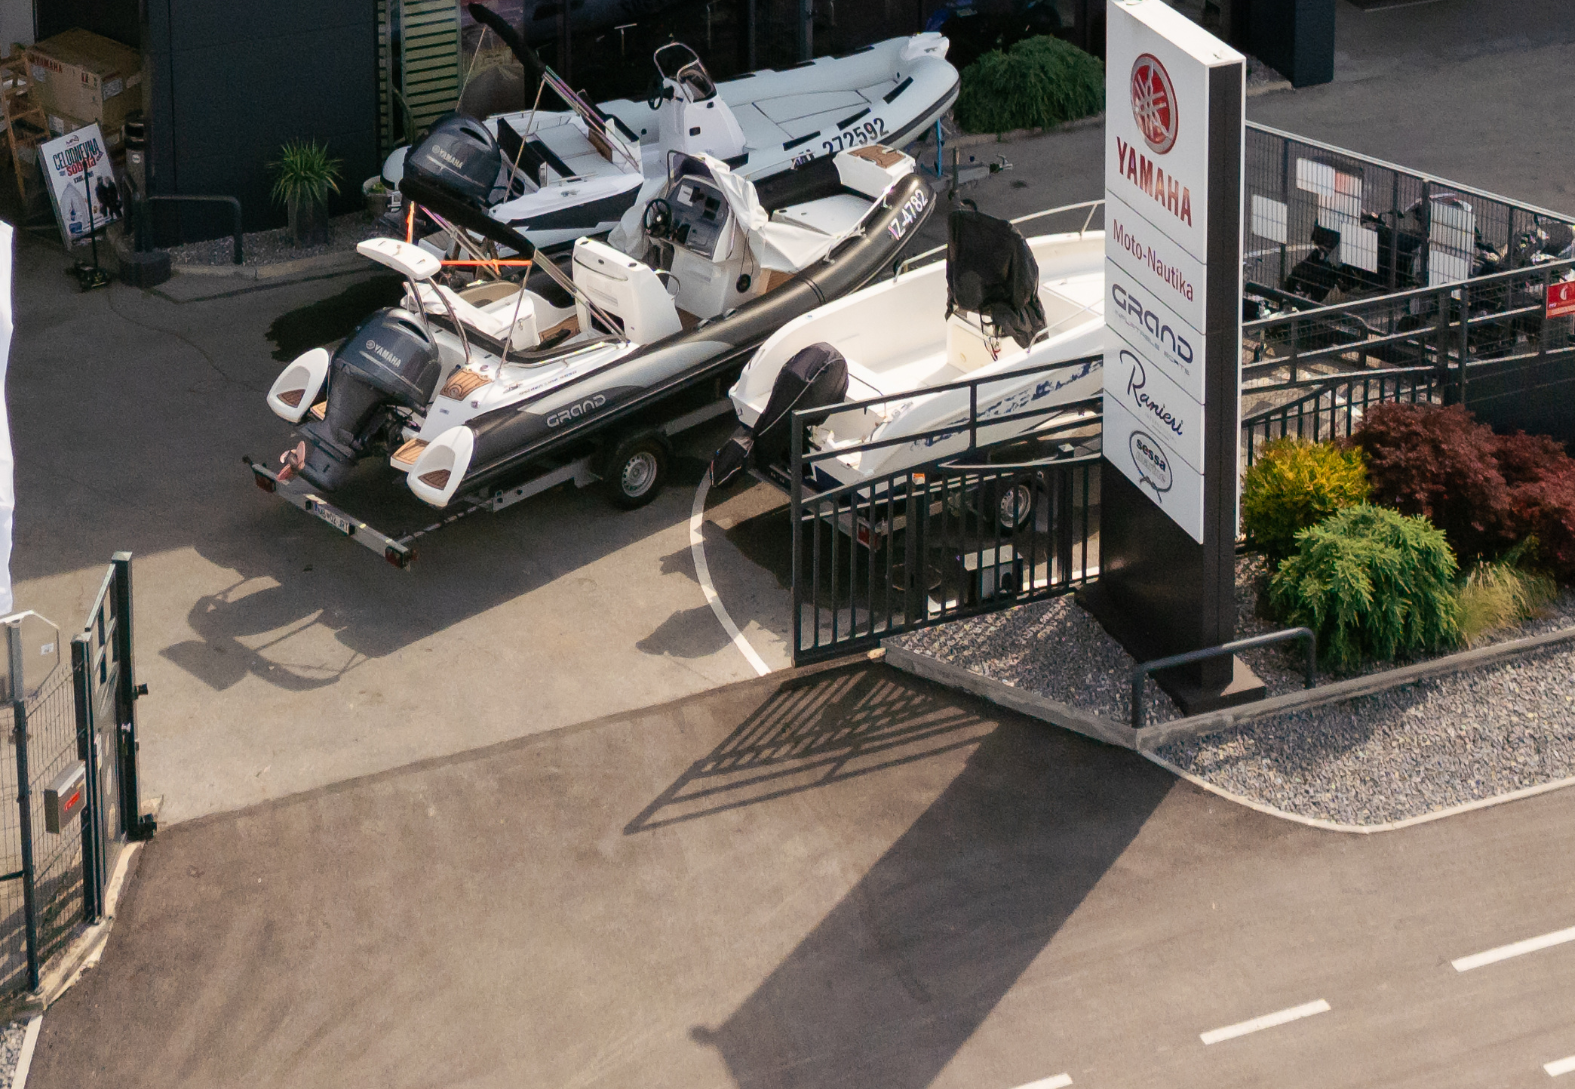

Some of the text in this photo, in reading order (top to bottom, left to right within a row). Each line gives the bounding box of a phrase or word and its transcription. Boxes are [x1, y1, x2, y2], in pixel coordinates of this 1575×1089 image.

[822, 117, 889, 154] 272592
[66, 157, 96, 176] sobta
[439, 149, 464, 169] YAMAHA
[1116, 136, 1192, 228] YAMAHA
[1113, 218, 1193, 302] Moto-Nautika
[1112, 283, 1194, 364] GRAND
[374, 344, 402, 368] YAMAHA
[1119, 349, 1183, 436] Ranieri
[546, 394, 606, 428] GRAND
[1136, 439, 1167, 472] sessa
